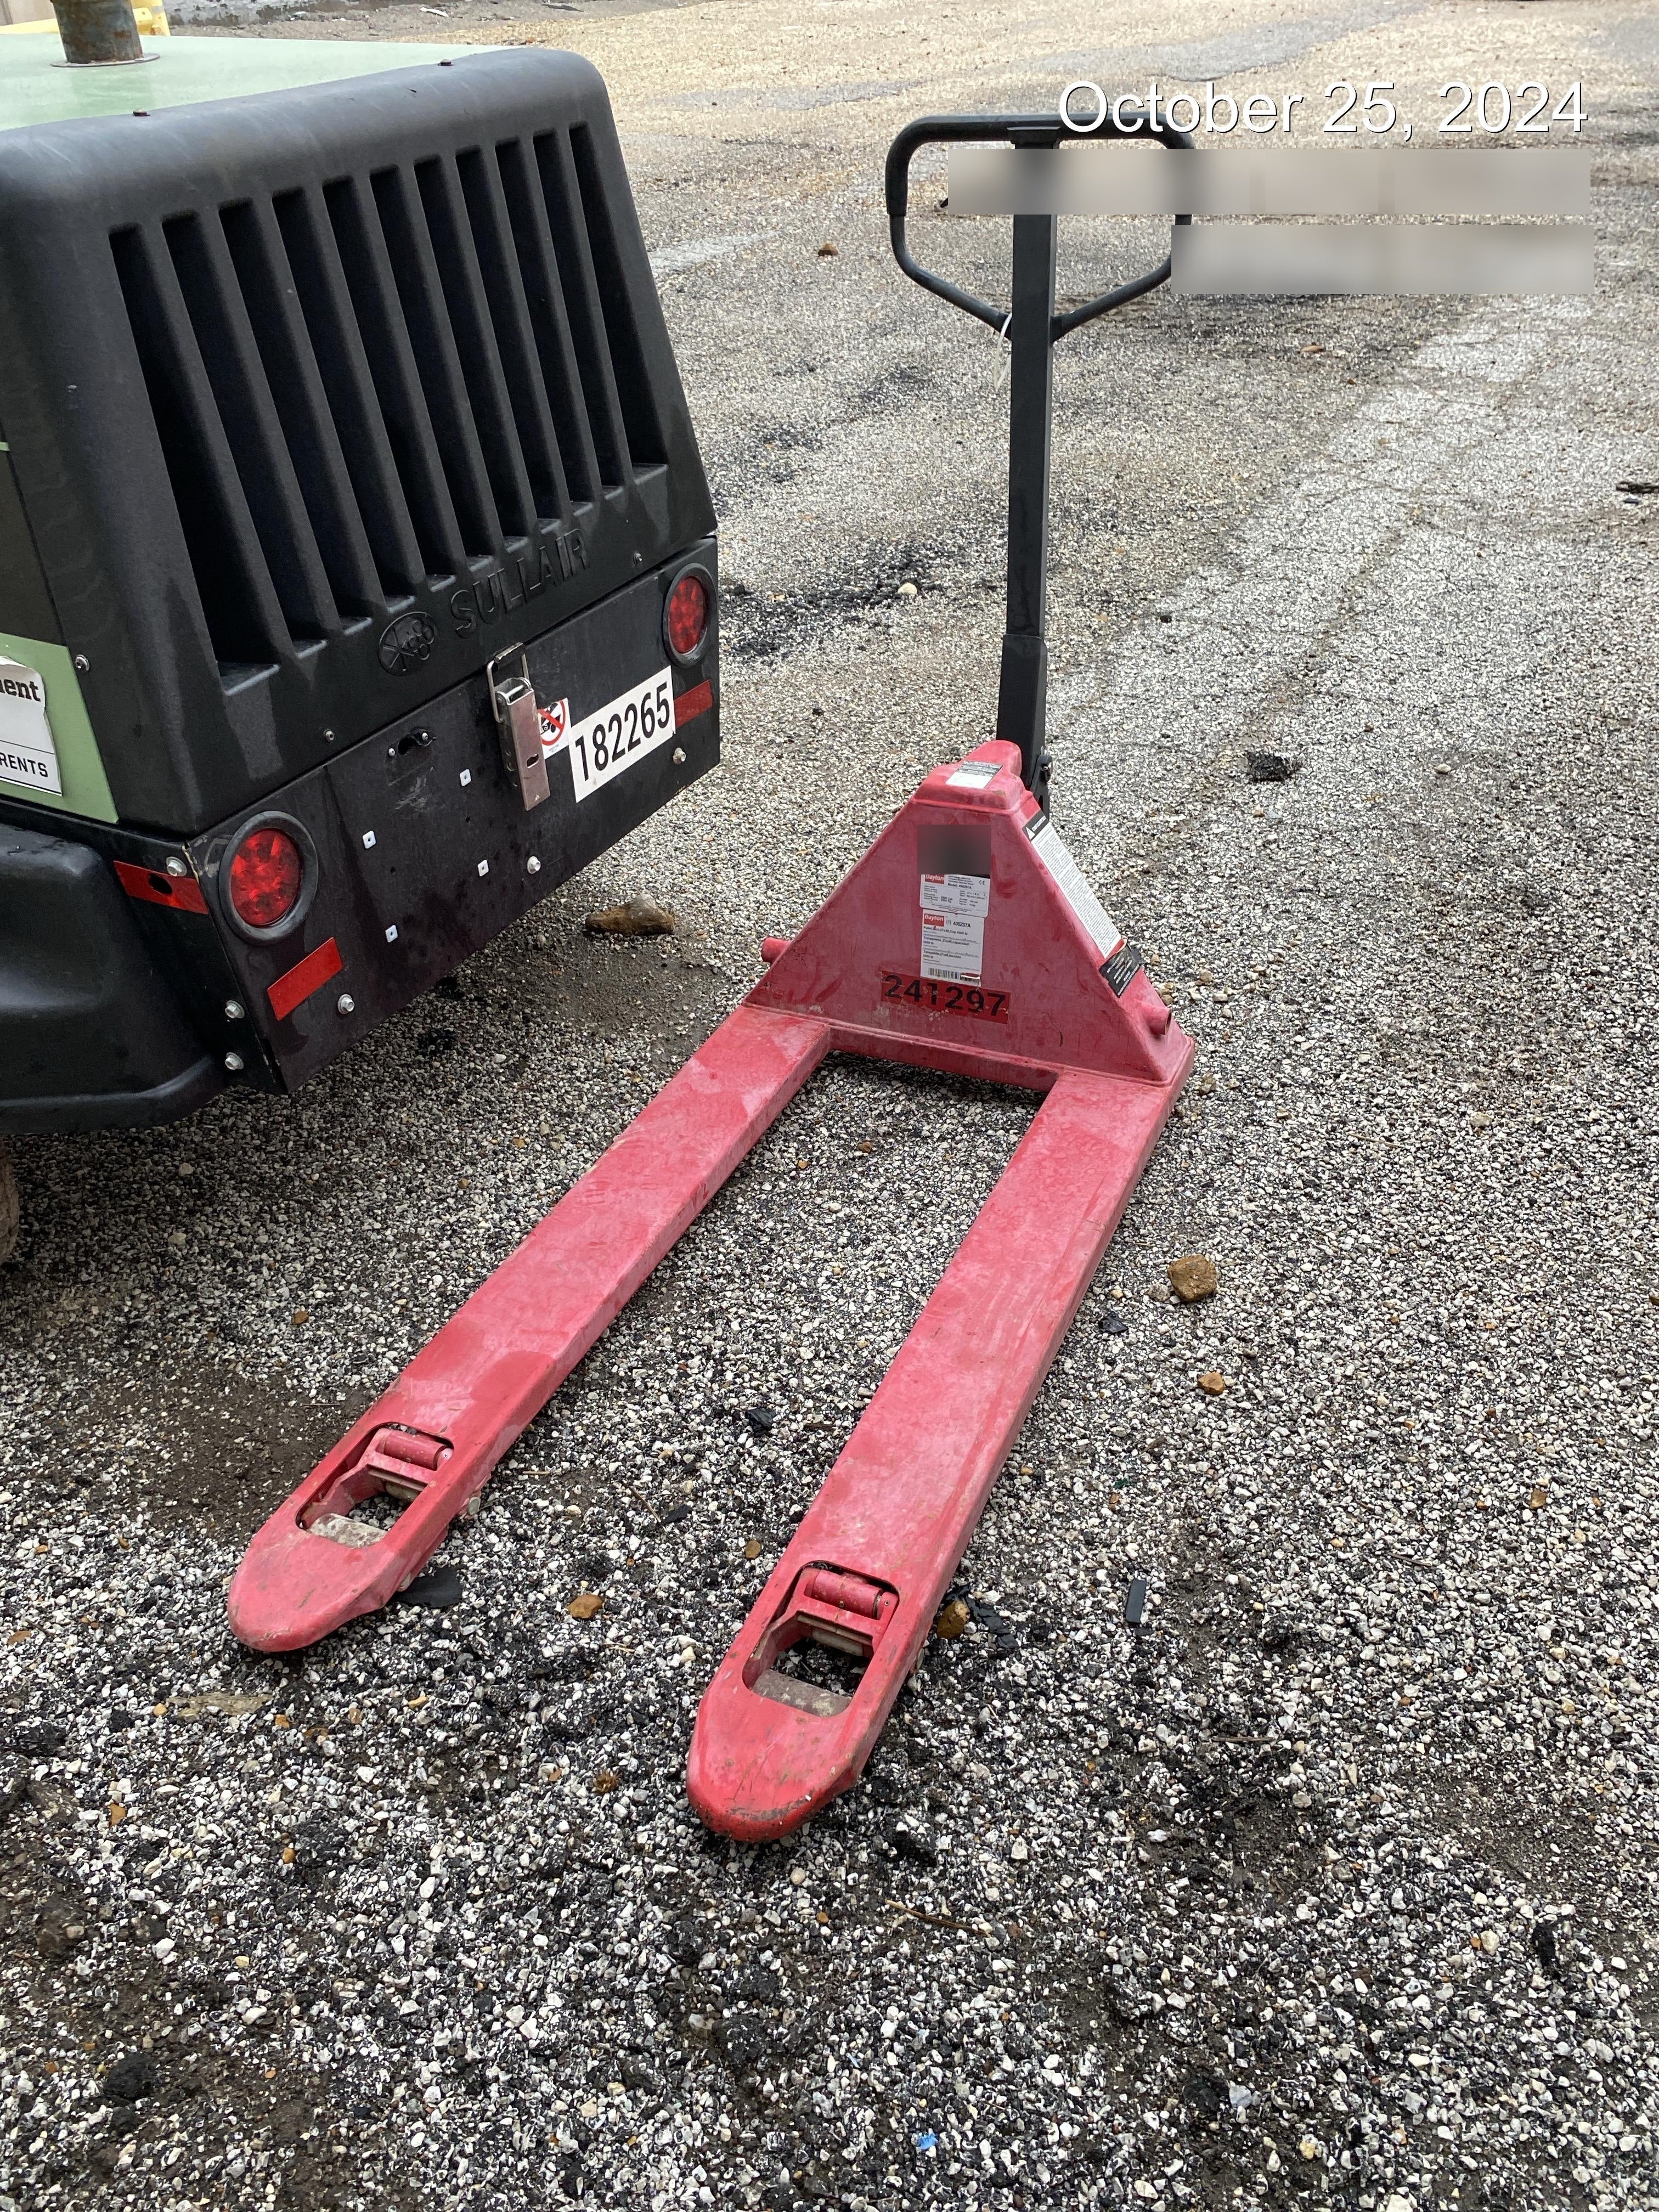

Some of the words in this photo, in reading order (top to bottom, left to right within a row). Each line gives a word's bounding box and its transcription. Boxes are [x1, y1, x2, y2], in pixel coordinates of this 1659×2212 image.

[450, 528, 587, 638] SULLAIR
[0, 752, 48, 777] RENTS
[575, 681, 670, 781] 182265
[884, 974, 1006, 1017] 241297
